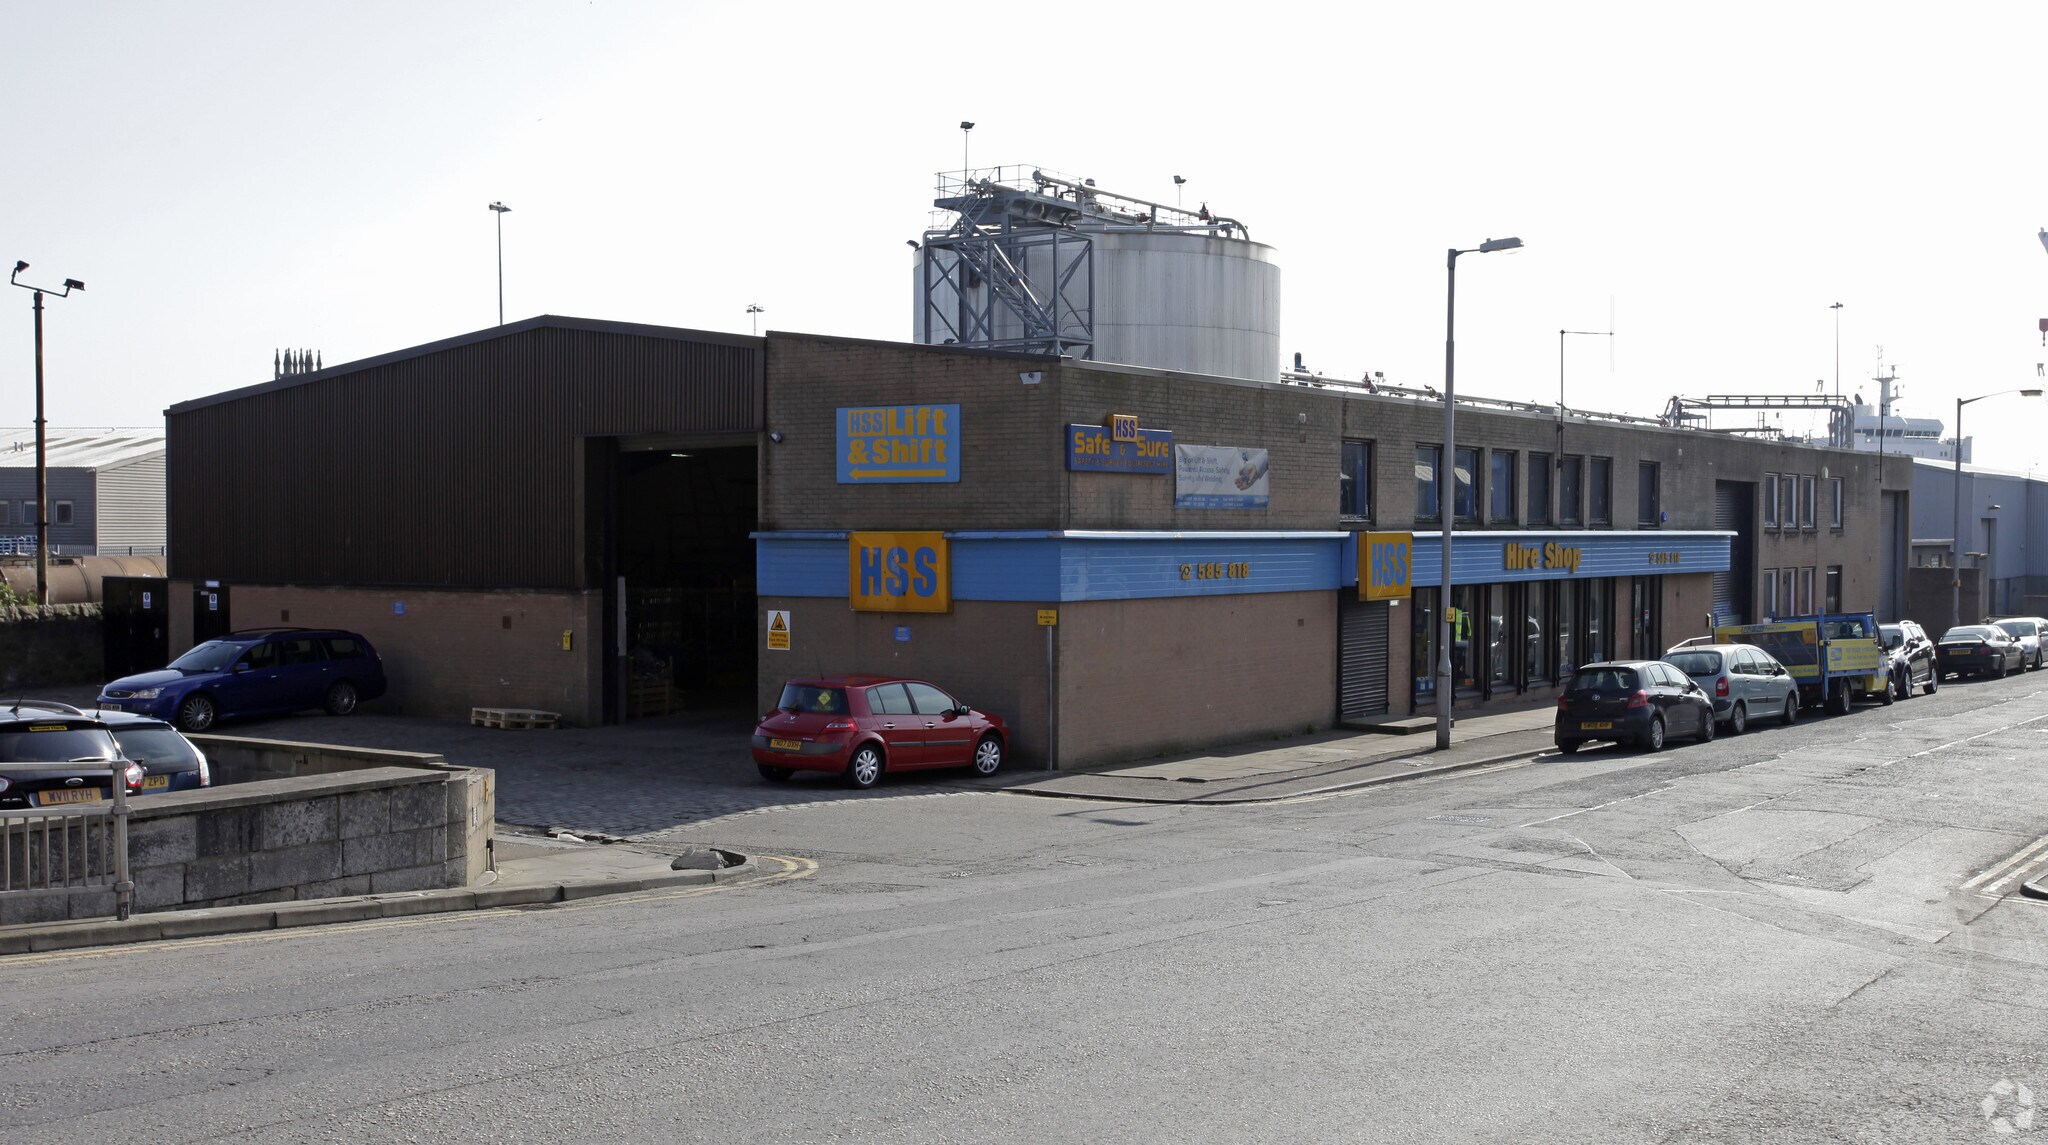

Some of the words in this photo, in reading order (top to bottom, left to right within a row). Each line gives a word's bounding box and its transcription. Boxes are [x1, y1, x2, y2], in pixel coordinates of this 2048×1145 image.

[850, 411, 884, 433] HSS
[888, 408, 947, 436] Lift
[1115, 419, 1135, 438] HSS
[1074, 432, 1111, 455] Safe
[1136, 435, 1169, 457] Sure
[1198, 563, 1223, 579] 585
[1228, 562, 1249, 578] 818
[1371, 542, 1407, 587] HSS
[1505, 543, 1540, 570] Hire
[1544, 541, 1581, 574] Shop
[860, 546, 937, 597] HSS
[71, 789, 93, 801] RYH
